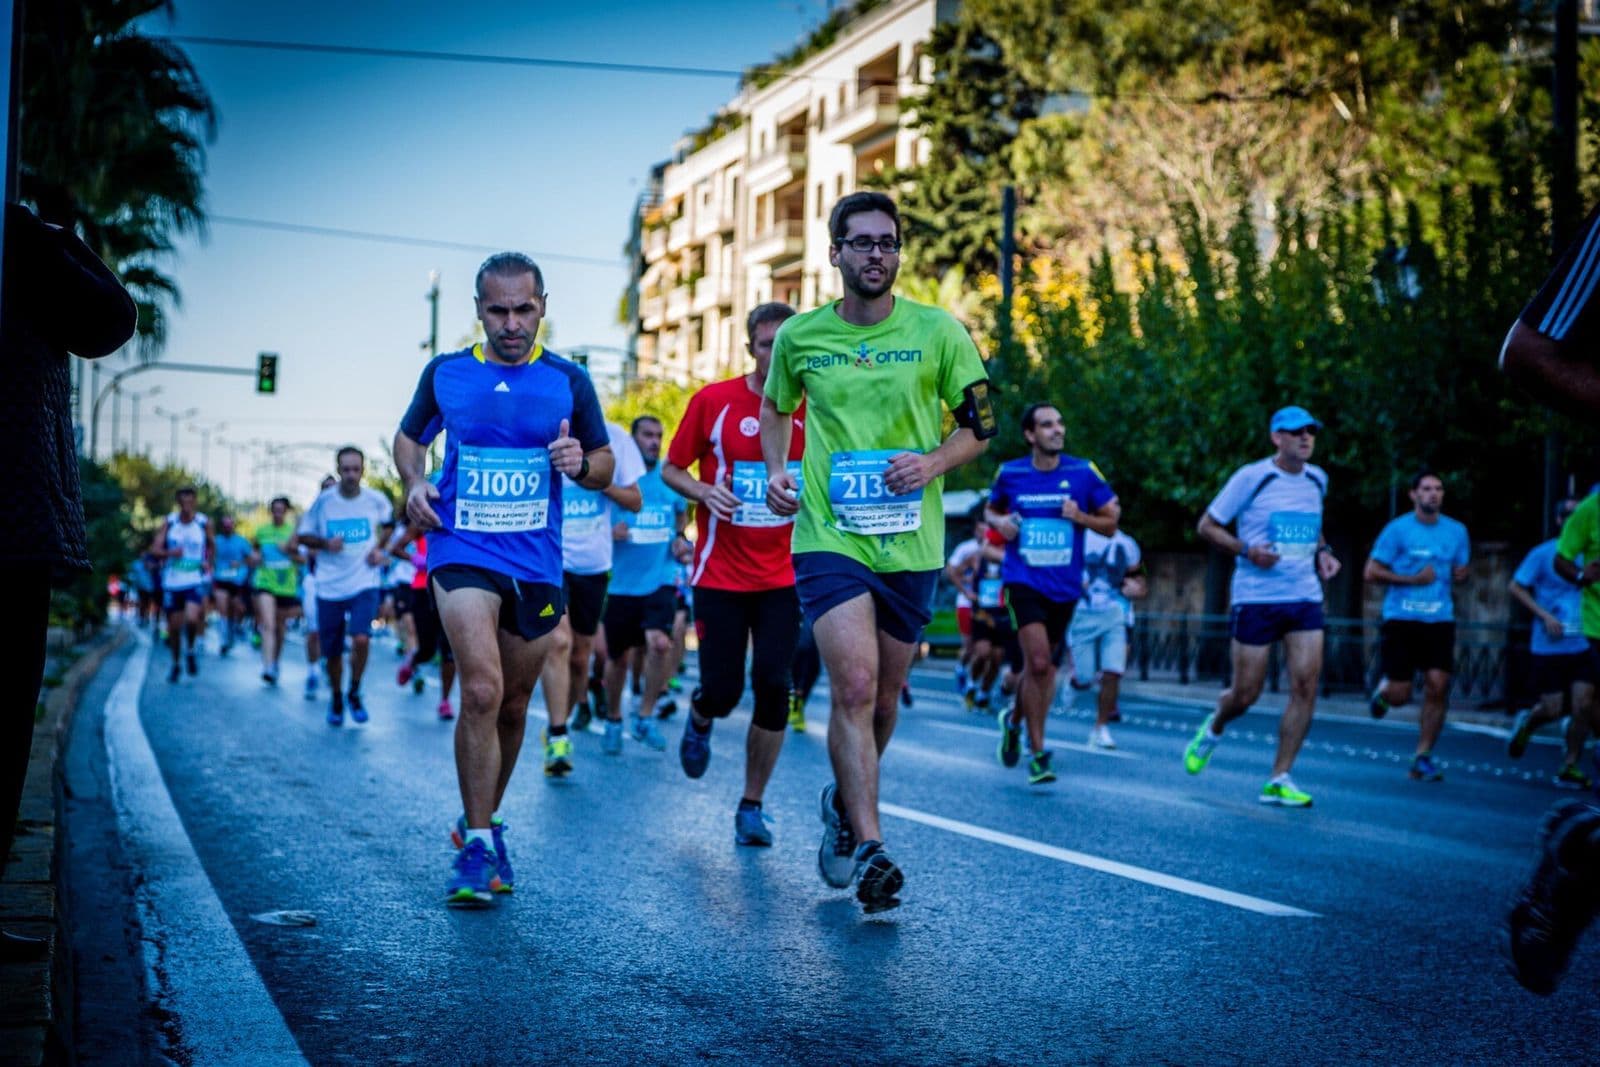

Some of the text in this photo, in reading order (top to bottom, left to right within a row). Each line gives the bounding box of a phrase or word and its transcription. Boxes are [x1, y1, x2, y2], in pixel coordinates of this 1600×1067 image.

[806, 353, 849, 369] team
[465, 470, 541, 497] 21009
[742, 479, 768, 499] 21
